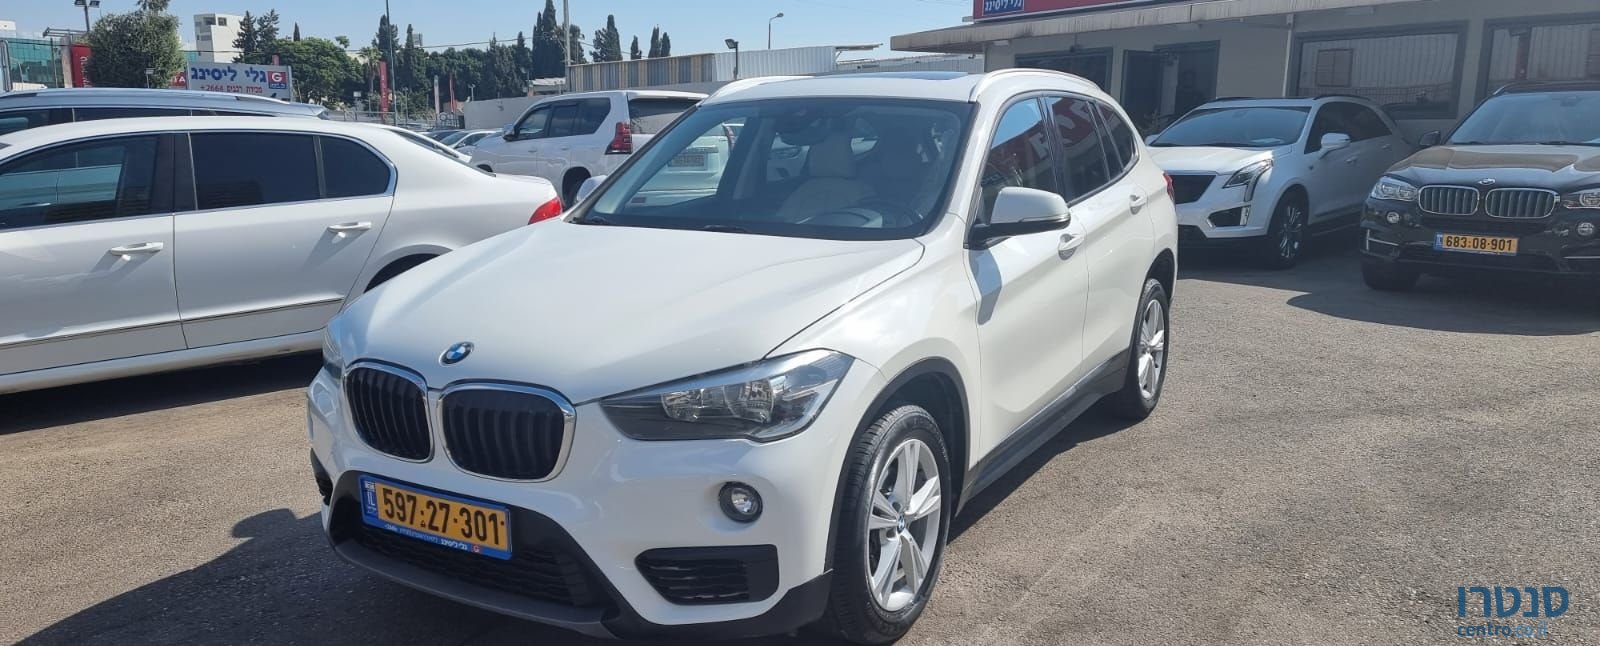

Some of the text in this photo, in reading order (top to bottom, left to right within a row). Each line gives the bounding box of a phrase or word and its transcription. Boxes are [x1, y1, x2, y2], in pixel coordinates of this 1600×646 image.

[190, 66, 267, 83] גלי ליסינג
[271, 72, 282, 82] G
